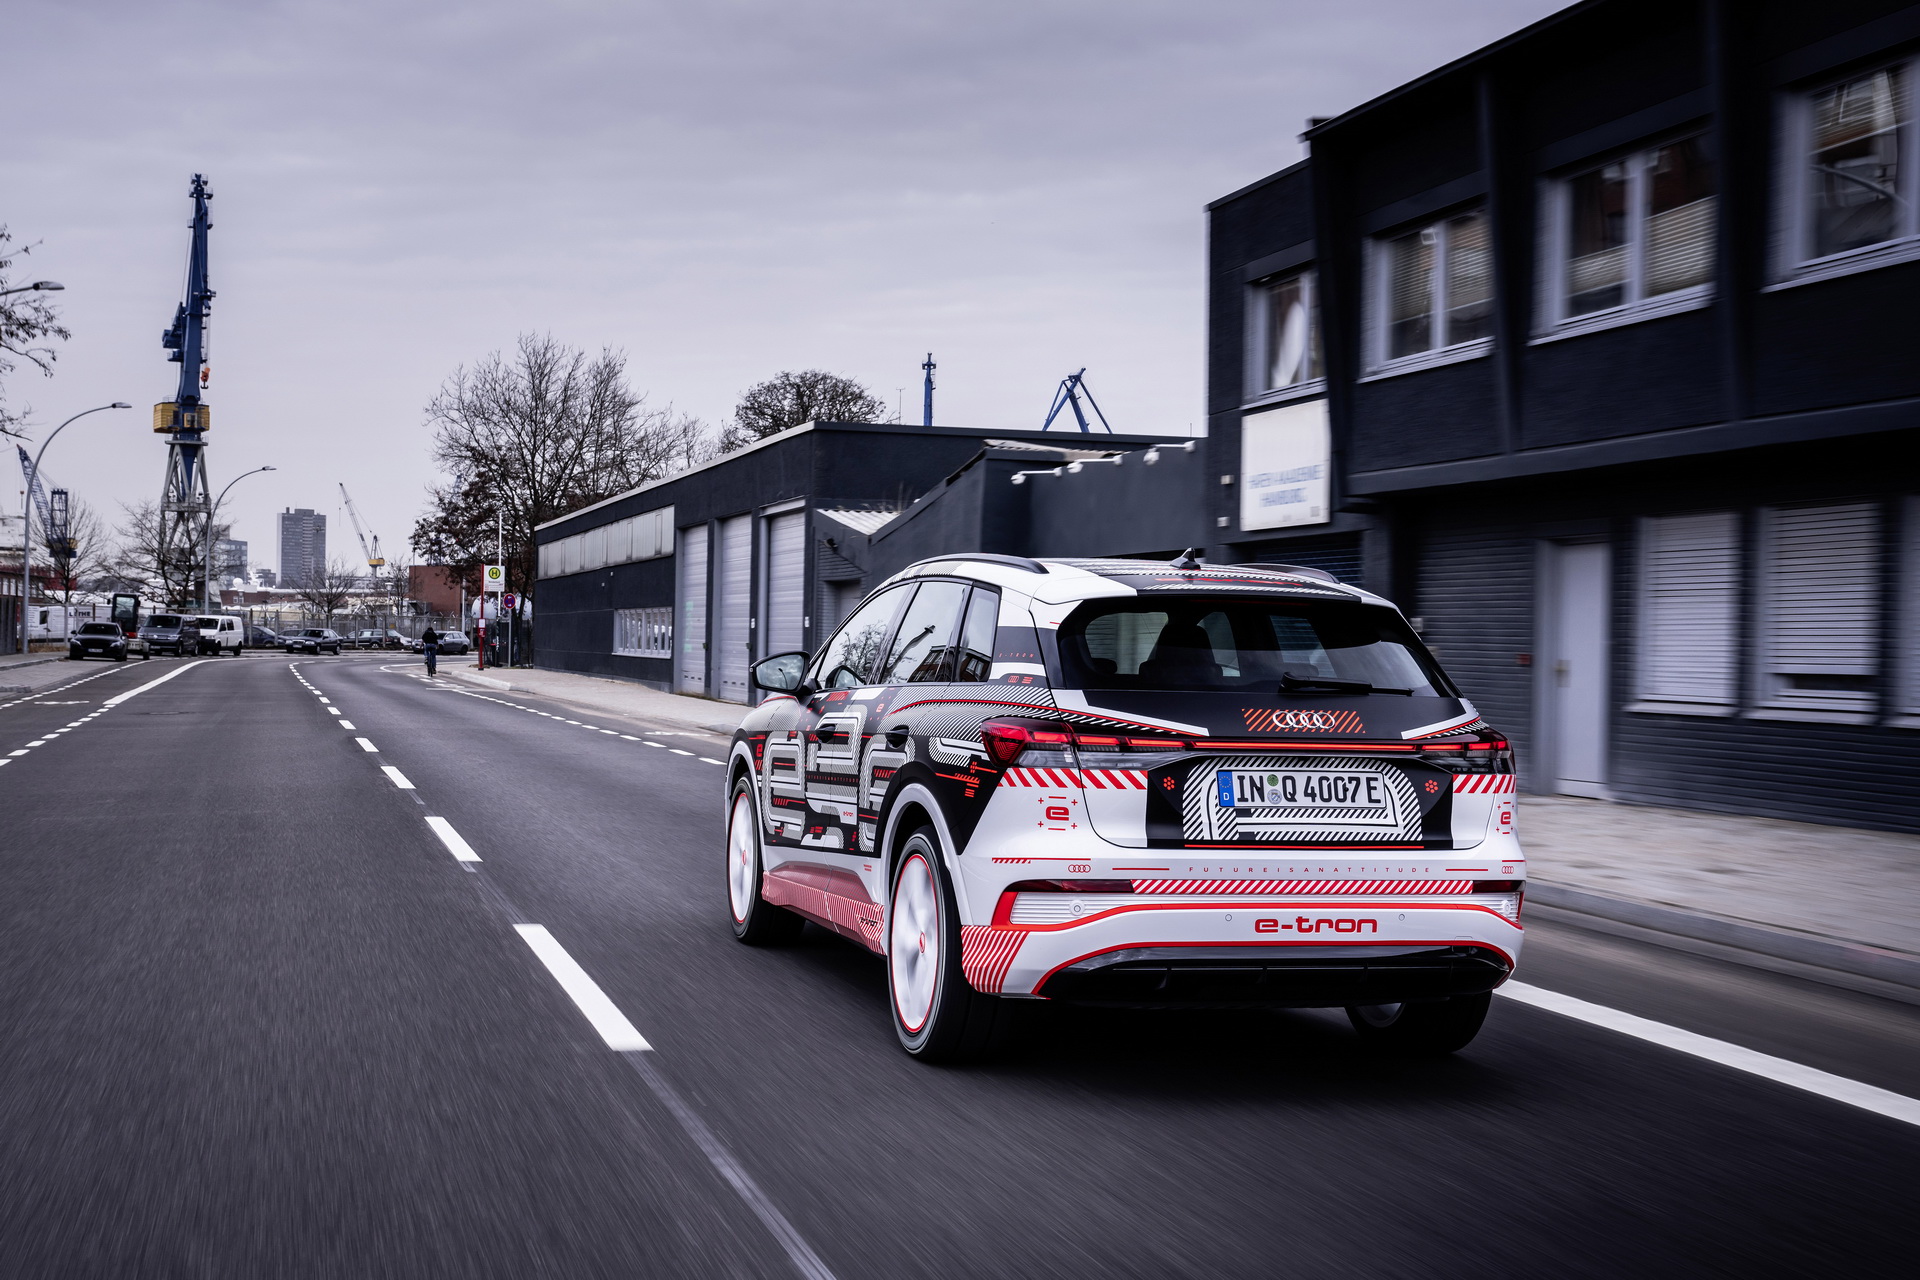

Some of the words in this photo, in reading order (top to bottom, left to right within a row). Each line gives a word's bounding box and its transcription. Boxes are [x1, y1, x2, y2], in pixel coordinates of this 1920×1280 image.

[1223, 792, 1230, 801] D
[1236, 775, 1266, 803] IN
[1282, 775, 1298, 803] Q
[1045, 805, 1070, 821] e
[1254, 915, 1378, 934] e-tron
